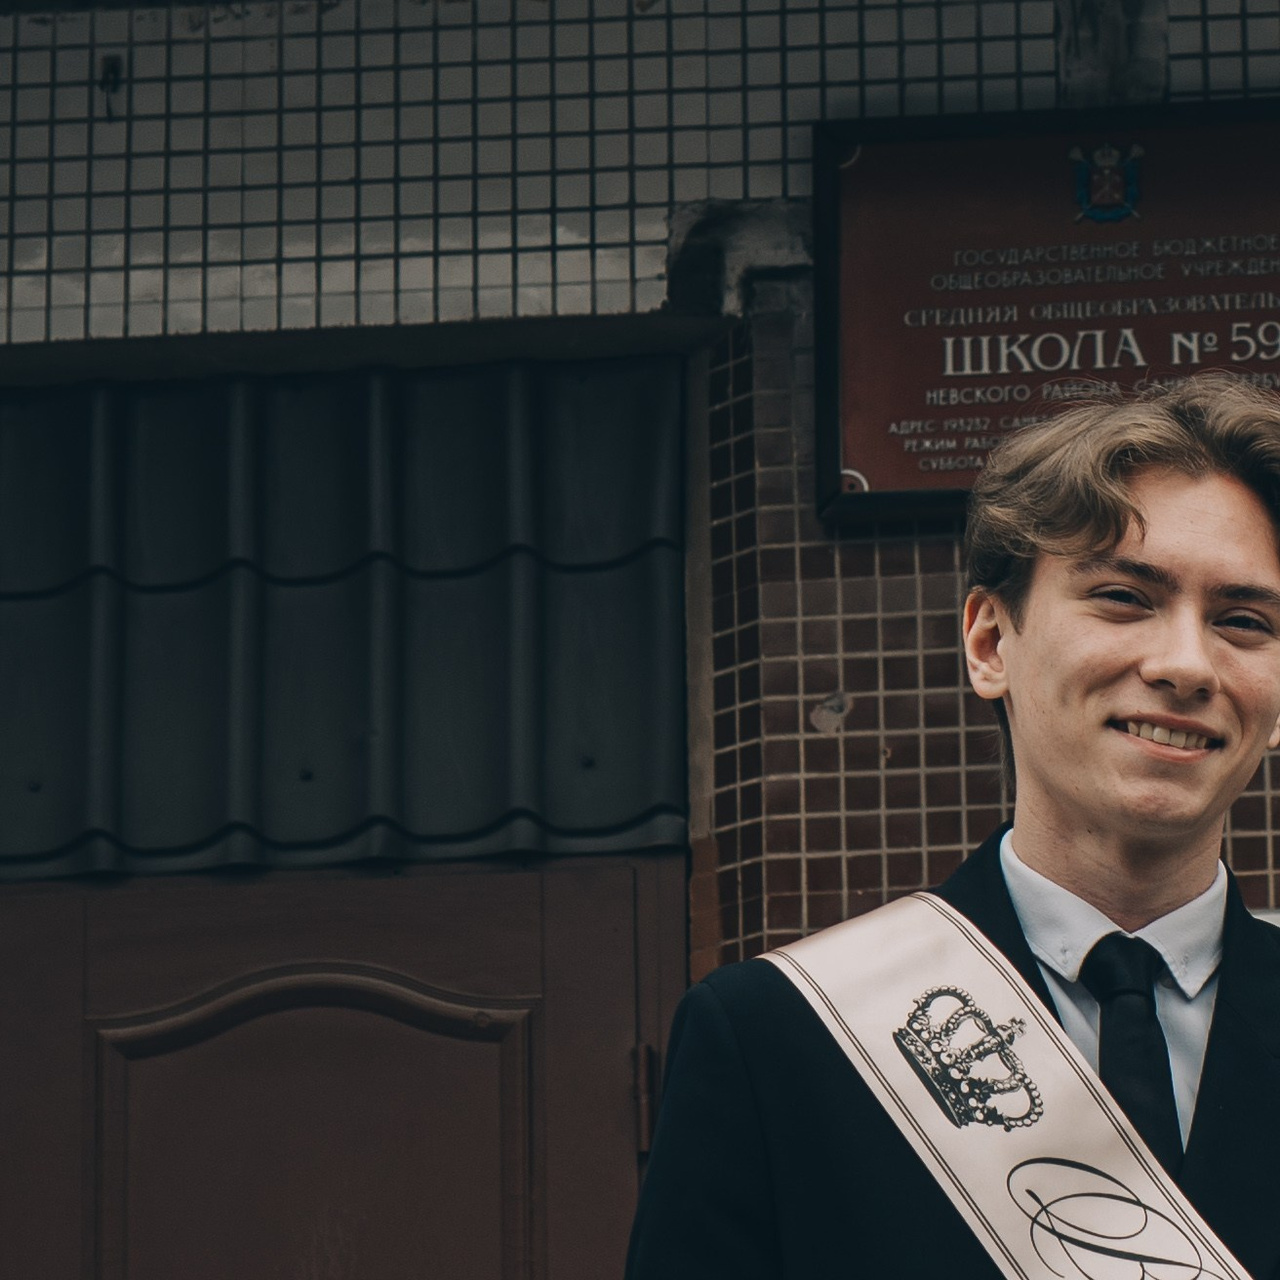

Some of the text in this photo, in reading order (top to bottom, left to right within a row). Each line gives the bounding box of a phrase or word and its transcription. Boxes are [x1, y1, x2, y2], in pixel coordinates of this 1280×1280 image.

[953, 233, 1279, 267] ГОСУДАРСТВЕННОЕ БЮДЖЕТНОЕ
[930, 263, 1166, 292] ОБЩЕОБРАЗОВАТЕЛЬНОЕ
[904, 303, 1019, 328] СРЕДНЯЯ
[942, 327, 1147, 377] ШКОЛА
[1170, 330, 1219, 365] №
[925, 383, 1031, 407] НЕВСКОГО
